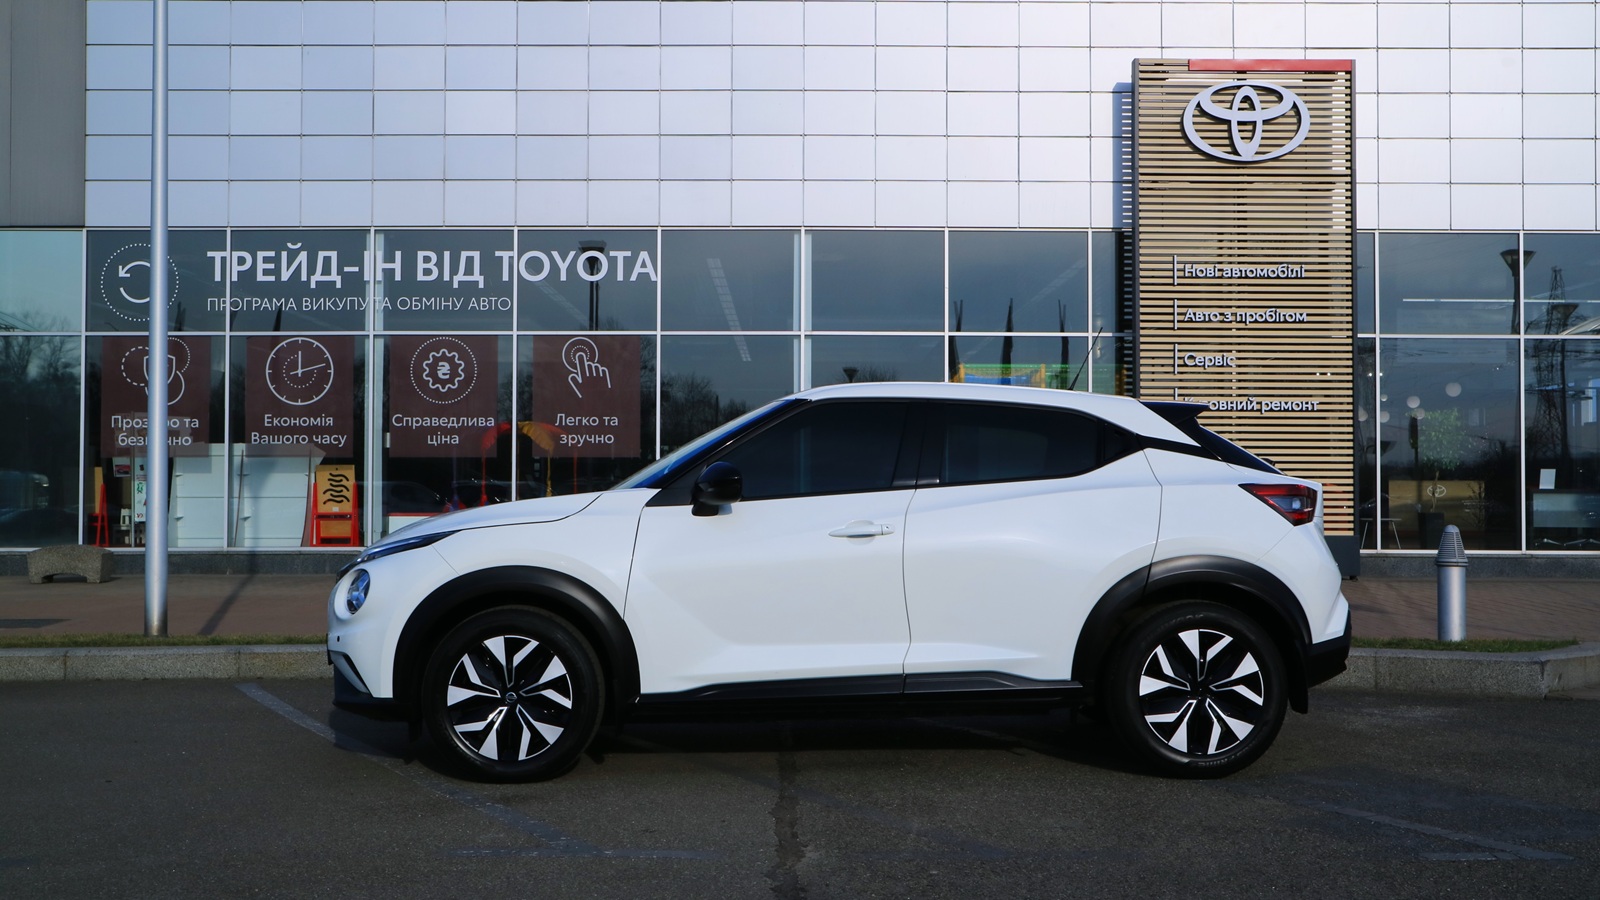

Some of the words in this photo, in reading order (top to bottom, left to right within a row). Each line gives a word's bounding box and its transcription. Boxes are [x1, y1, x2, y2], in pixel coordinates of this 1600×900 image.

[207, 242, 402, 289] ТРЕЙД-ІН
[416, 250, 485, 289] ВІД
[495, 250, 658, 283] TOYOTA
[1184, 264, 1218, 278] Нові
[1222, 264, 1305, 278] автомобілі
[207, 297, 297, 312] ПРОГРАМА
[302, 297, 369, 312] ВИКУПУ
[373, 297, 392, 311] ТА
[397, 297, 464, 312] ОБМІНУ
[467, 297, 512, 311] АВТО
[1184, 308, 1220, 322] Авто
[1223, 312, 1232, 322] з
[1236, 308, 1307, 325] пробігом
[1184, 352, 1237, 369] Сервіс
[1184, 397, 1257, 411] овний
[1262, 401, 1319, 414] ремонт
[184, 418, 199, 428] та
[264, 414, 334, 427] Економія
[392, 414, 495, 428] Справедлива
[555, 414, 599, 427] Легко
[602, 416, 619, 426] та
[251, 432, 309, 445] Вашого
[312, 434, 347, 447] часу
[427, 432, 460, 447] ціна
[559, 433, 615, 446] зручно
